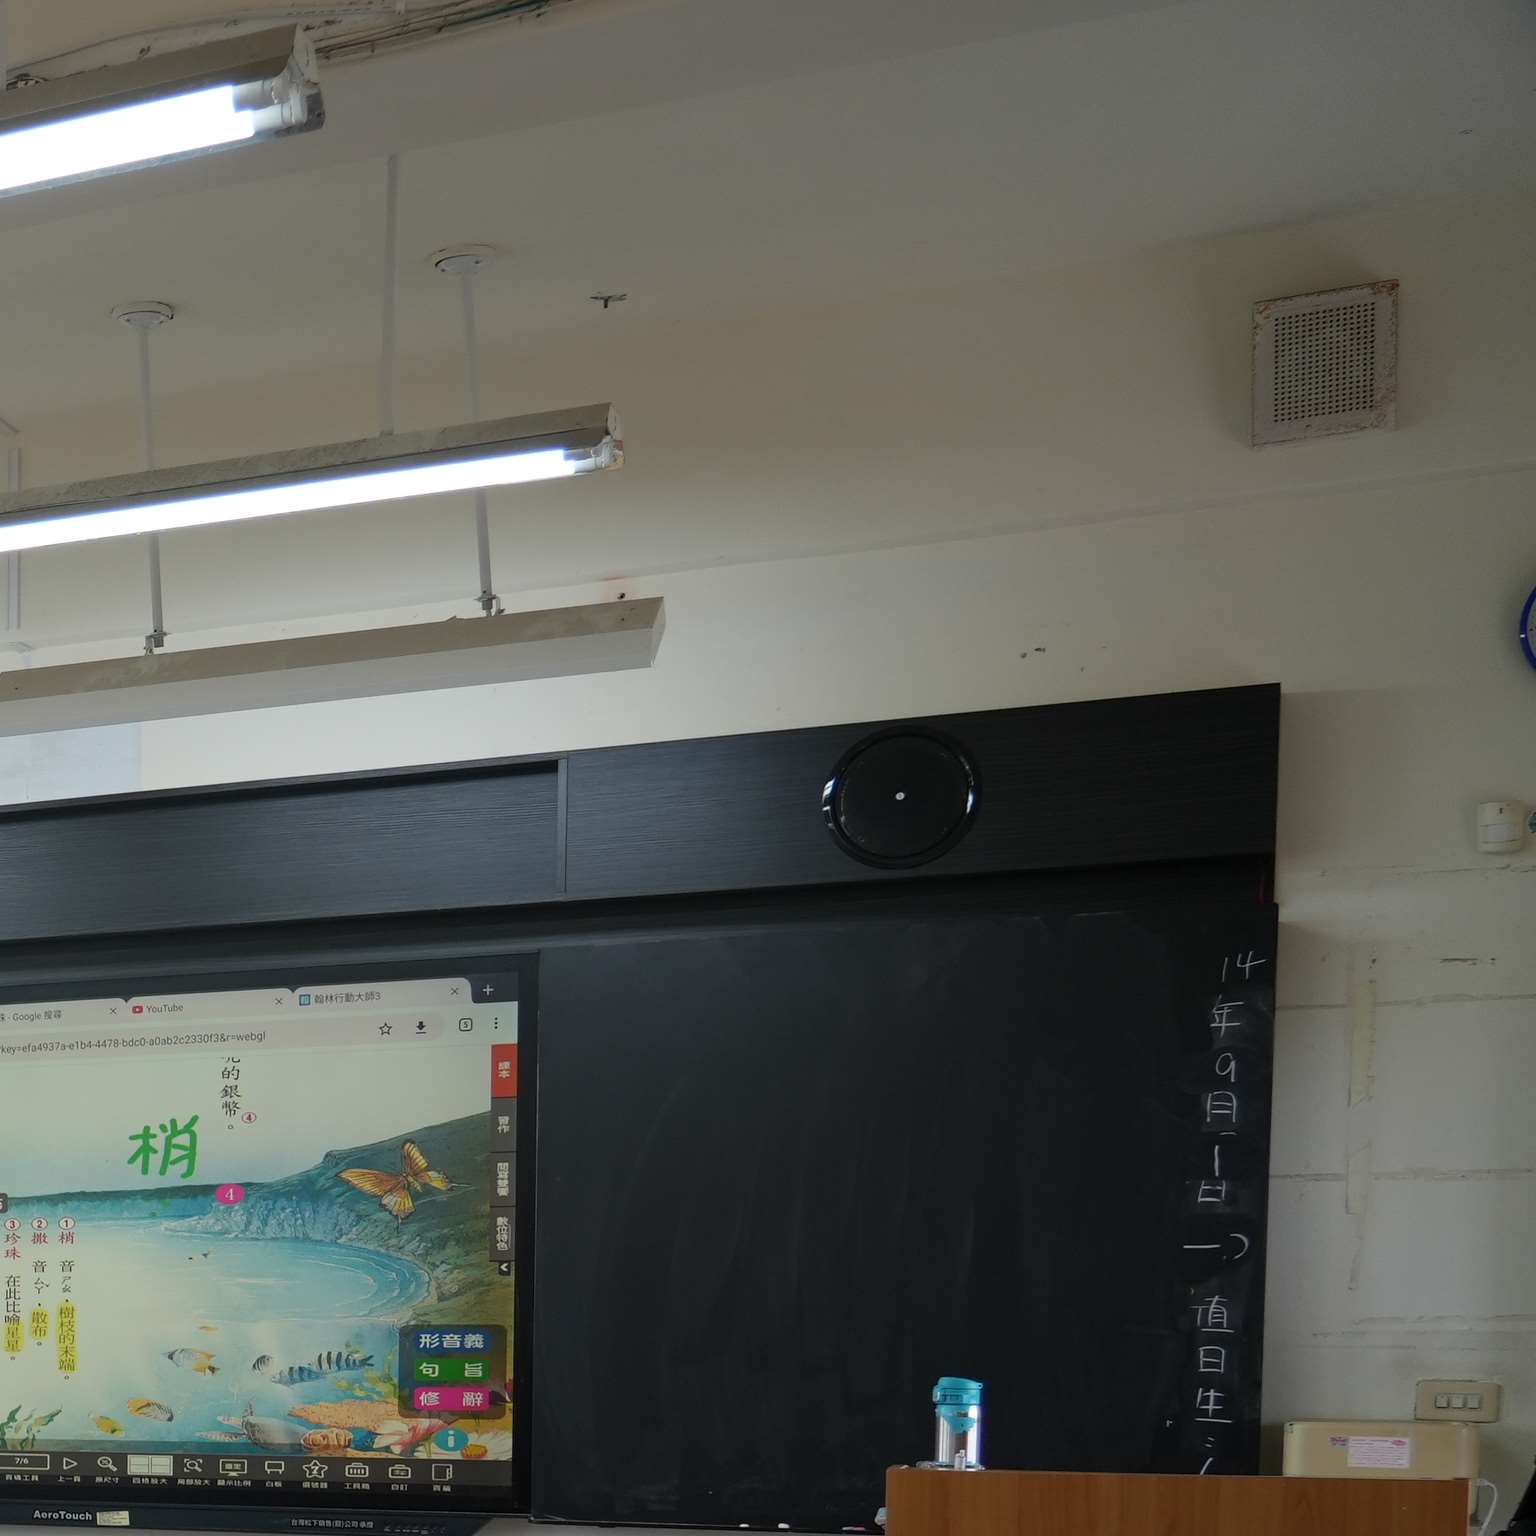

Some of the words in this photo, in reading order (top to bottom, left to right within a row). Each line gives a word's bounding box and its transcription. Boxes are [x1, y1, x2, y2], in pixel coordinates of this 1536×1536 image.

[146, 1003, 183, 1013] YouTube
[12, 1011, 42, 1022] Google
[127, 1114, 199, 1179] 梢
[419, 1333, 484, 1349] 形音義
[15, 1457, 29, 1465] 7/6
[33, 1509, 93, 1521] AeroTouch
